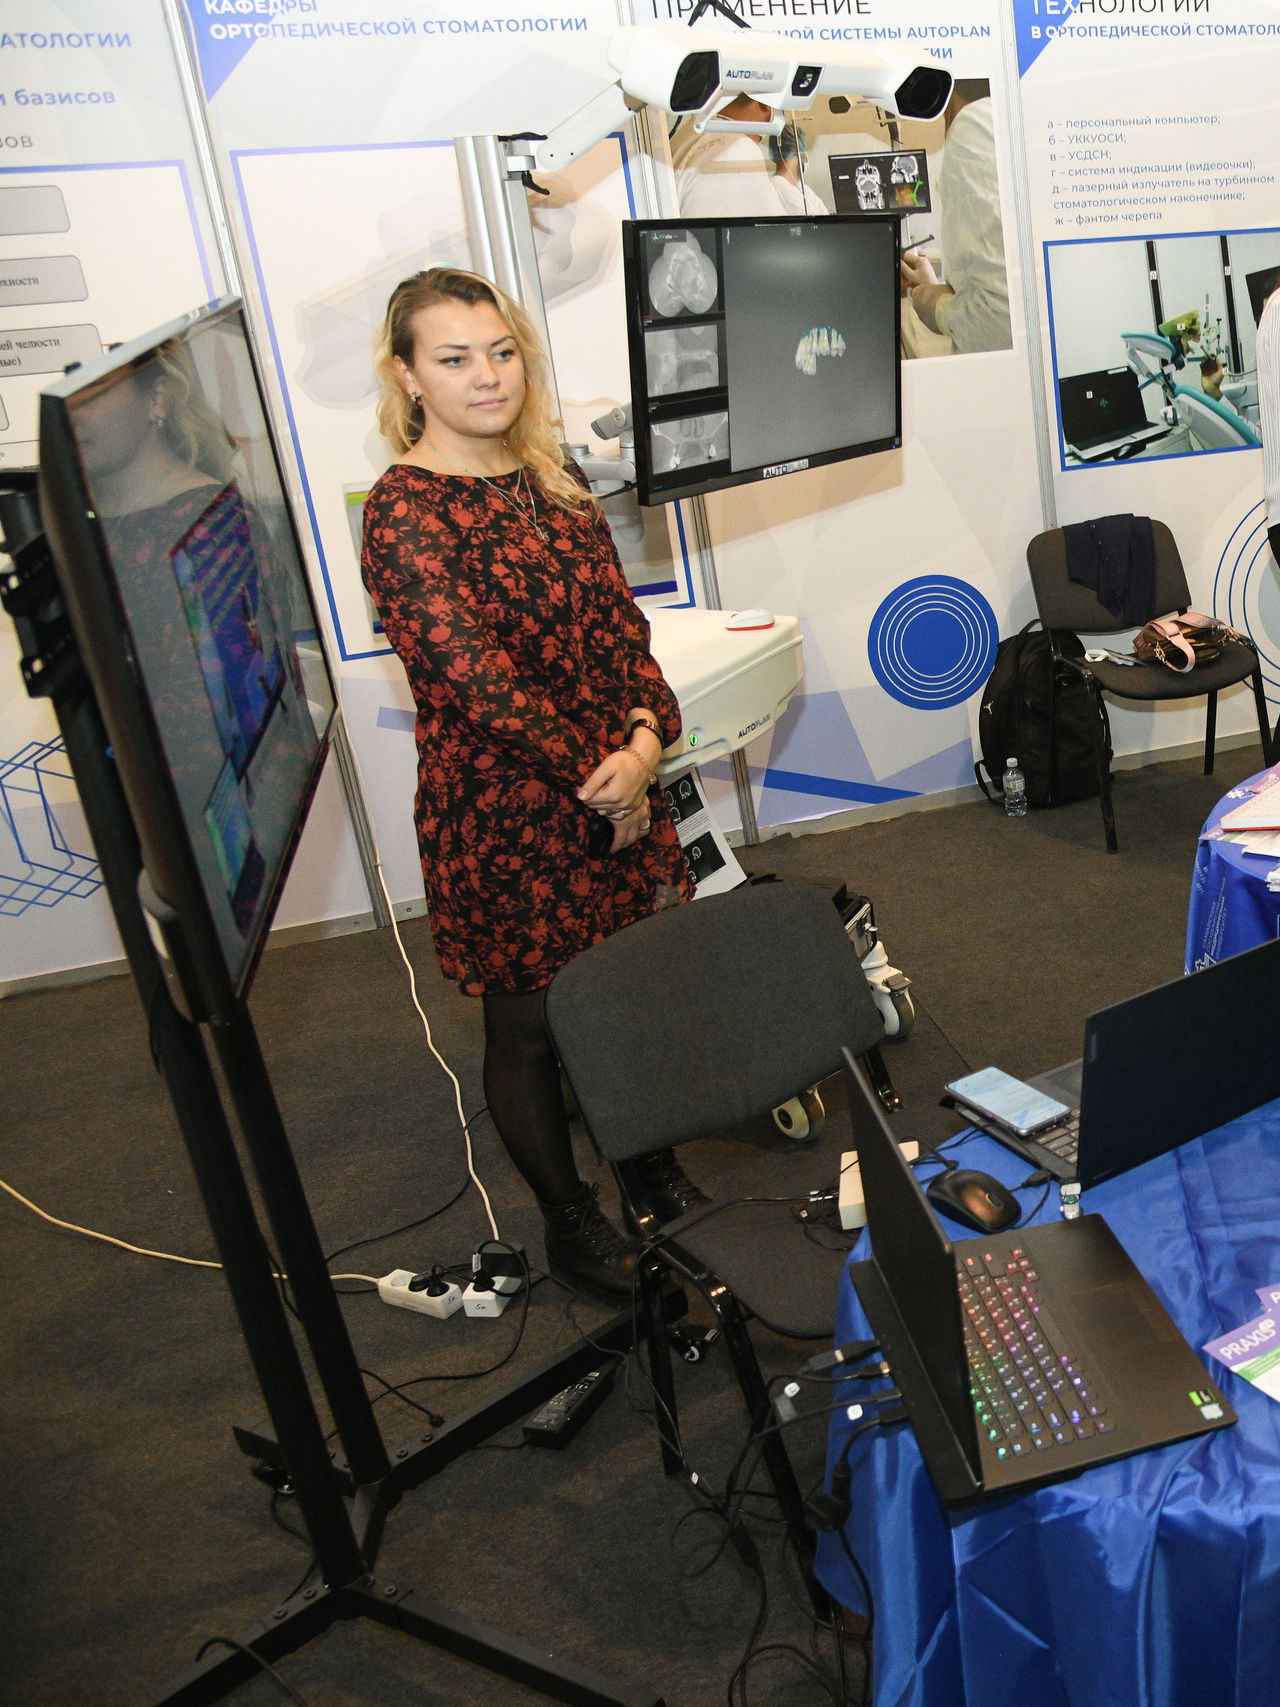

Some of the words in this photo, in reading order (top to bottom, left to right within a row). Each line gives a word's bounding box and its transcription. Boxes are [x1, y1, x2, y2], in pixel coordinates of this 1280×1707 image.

[652, 0, 872, 19] ПРМЕНЕНИЕ
[210, 17, 417, 41] ОРТОПЕДИЧЕСКОЙ
[422, 17, 589, 35] СТОМАТОЛОГИИ
[820, 27, 902, 41] СИСТЕМЫ
[907, 25, 991, 39] AUTOPLAN
[1031, 25, 1042, 39] В
[1045, 22, 1192, 39] ОРТОПЕДИЧЕСКОЙ
[725, 69, 774, 81] AUTOPLAN
[15, 88, 116, 106] базисов
[1047, 121, 1054, 129] а
[1065, 115, 1151, 129] персональный
[1154, 114, 1221, 127] компьютер;
[1048, 135, 1056, 145] б
[1067, 133, 1127, 145] УККУОСИ;
[1050, 152, 1057, 161] в
[1068, 150, 1112, 162] УСДСН;
[1051, 169, 1056, 177] г
[1068, 166, 1116, 177] система
[1119, 163, 1183, 175] индикации
[1185, 159, 1256, 174] (видеоочки);
[1052, 185, 1060, 194] д
[1071, 180, 1129, 194] лазерный
[1132, 178, 1195, 192] излучатель
[1198, 177, 1211, 187] на
[1214, 175, 1275, 189] турбинном
[1053, 195, 1167, 210] стоматологическом
[1170, 191, 1245, 205] наконечнике;
[1055, 217, 1064, 226] ж
[1075, 213, 1119, 227] фантом
[1122, 211, 1163, 224] черепа
[16, 337, 61, 350] челюсти
[1219, 1325, 1277, 1360] PRAXIS
